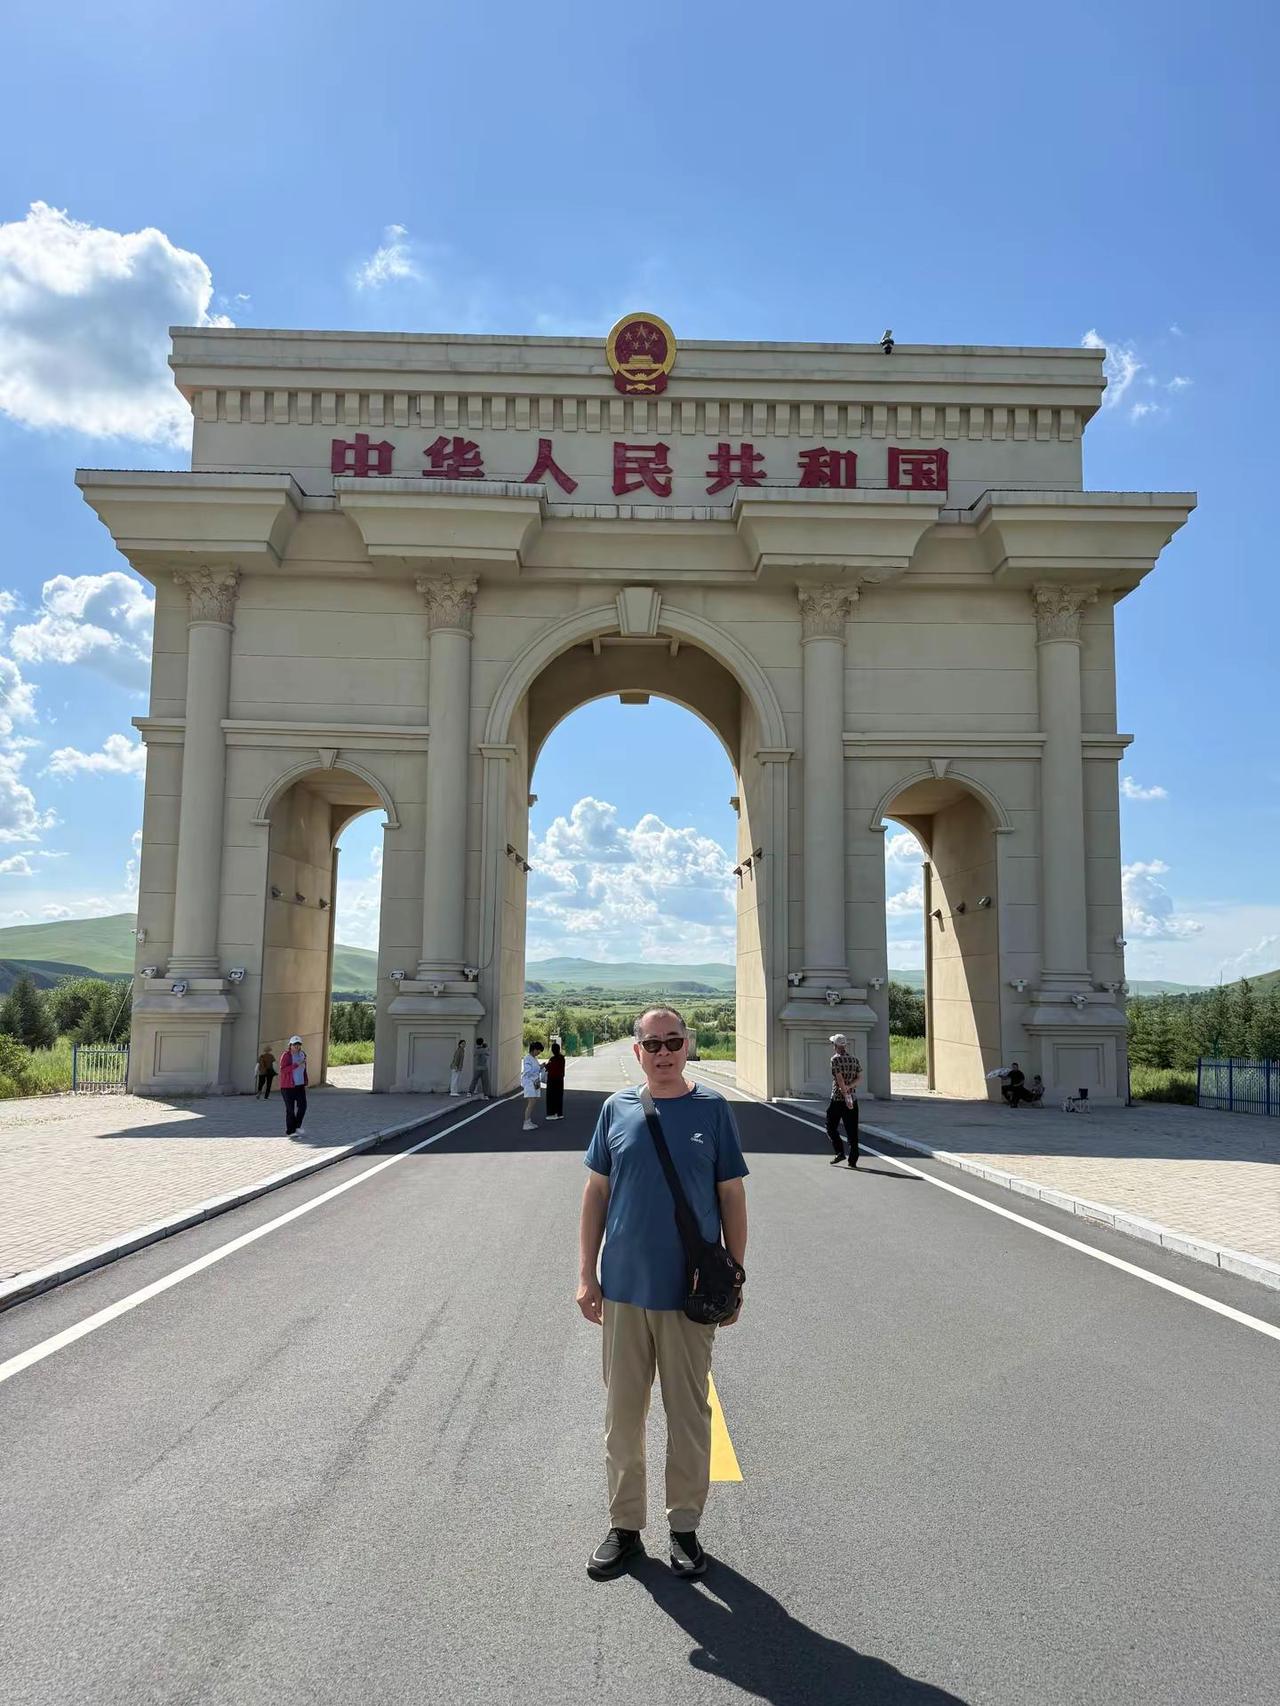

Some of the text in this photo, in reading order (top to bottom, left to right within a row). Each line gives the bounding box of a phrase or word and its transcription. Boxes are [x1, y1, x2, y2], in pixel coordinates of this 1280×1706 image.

[331, 433, 949, 497] 中华人民共和国
